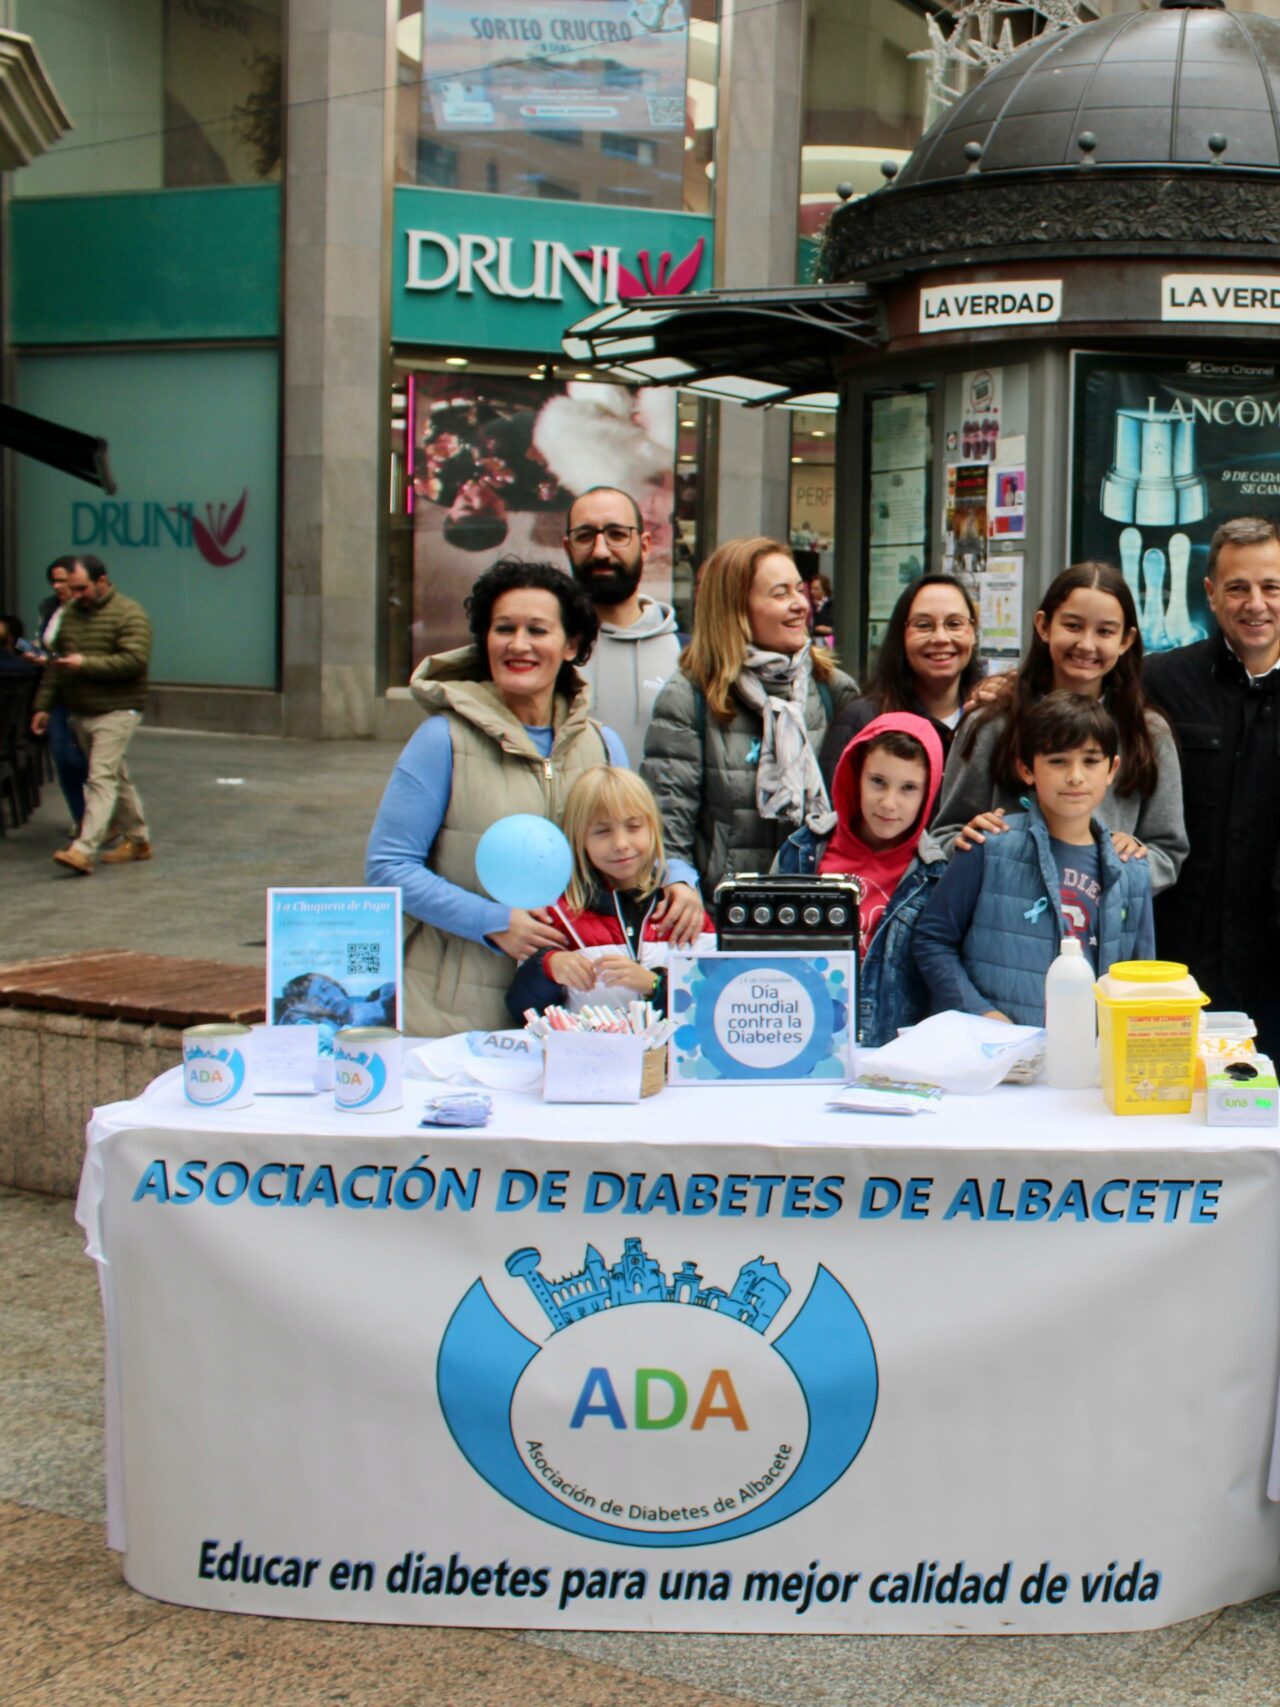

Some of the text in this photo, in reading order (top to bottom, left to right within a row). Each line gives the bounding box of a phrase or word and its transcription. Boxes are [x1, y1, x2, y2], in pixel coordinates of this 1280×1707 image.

[470, 17, 632, 41] SORTEO CRUCERO
[405, 229, 621, 305] DRUNI
[925, 292, 1054, 319] LA VERDAD
[1169, 287, 1207, 308] LA
[1203, 363, 1274, 377] Clear Channel
[1232, 471, 1250, 482] DE
[1250, 471, 1280, 482] CADA
[1240, 483, 1256, 494] SE
[70, 501, 194, 547] DRUNI
[347, 901, 361, 911] de
[731, 1000, 799, 1014] mundial
[728, 1015, 802, 1029] contra la
[483, 1033, 530, 1053] ADA
[727, 1030, 803, 1044] Diabetes
[190, 1070, 222, 1083] ADA
[131, 1154, 1223, 1225] ASOCIACIÓN DE DIABETES DE ALBACETE
[569, 1367, 749, 1431] ADA
[525, 1439, 793, 1521] Asociación de Diabetes de Albacete
[197, 1539, 1164, 1614] Educar en diabetes para una mejor calidad de vida
